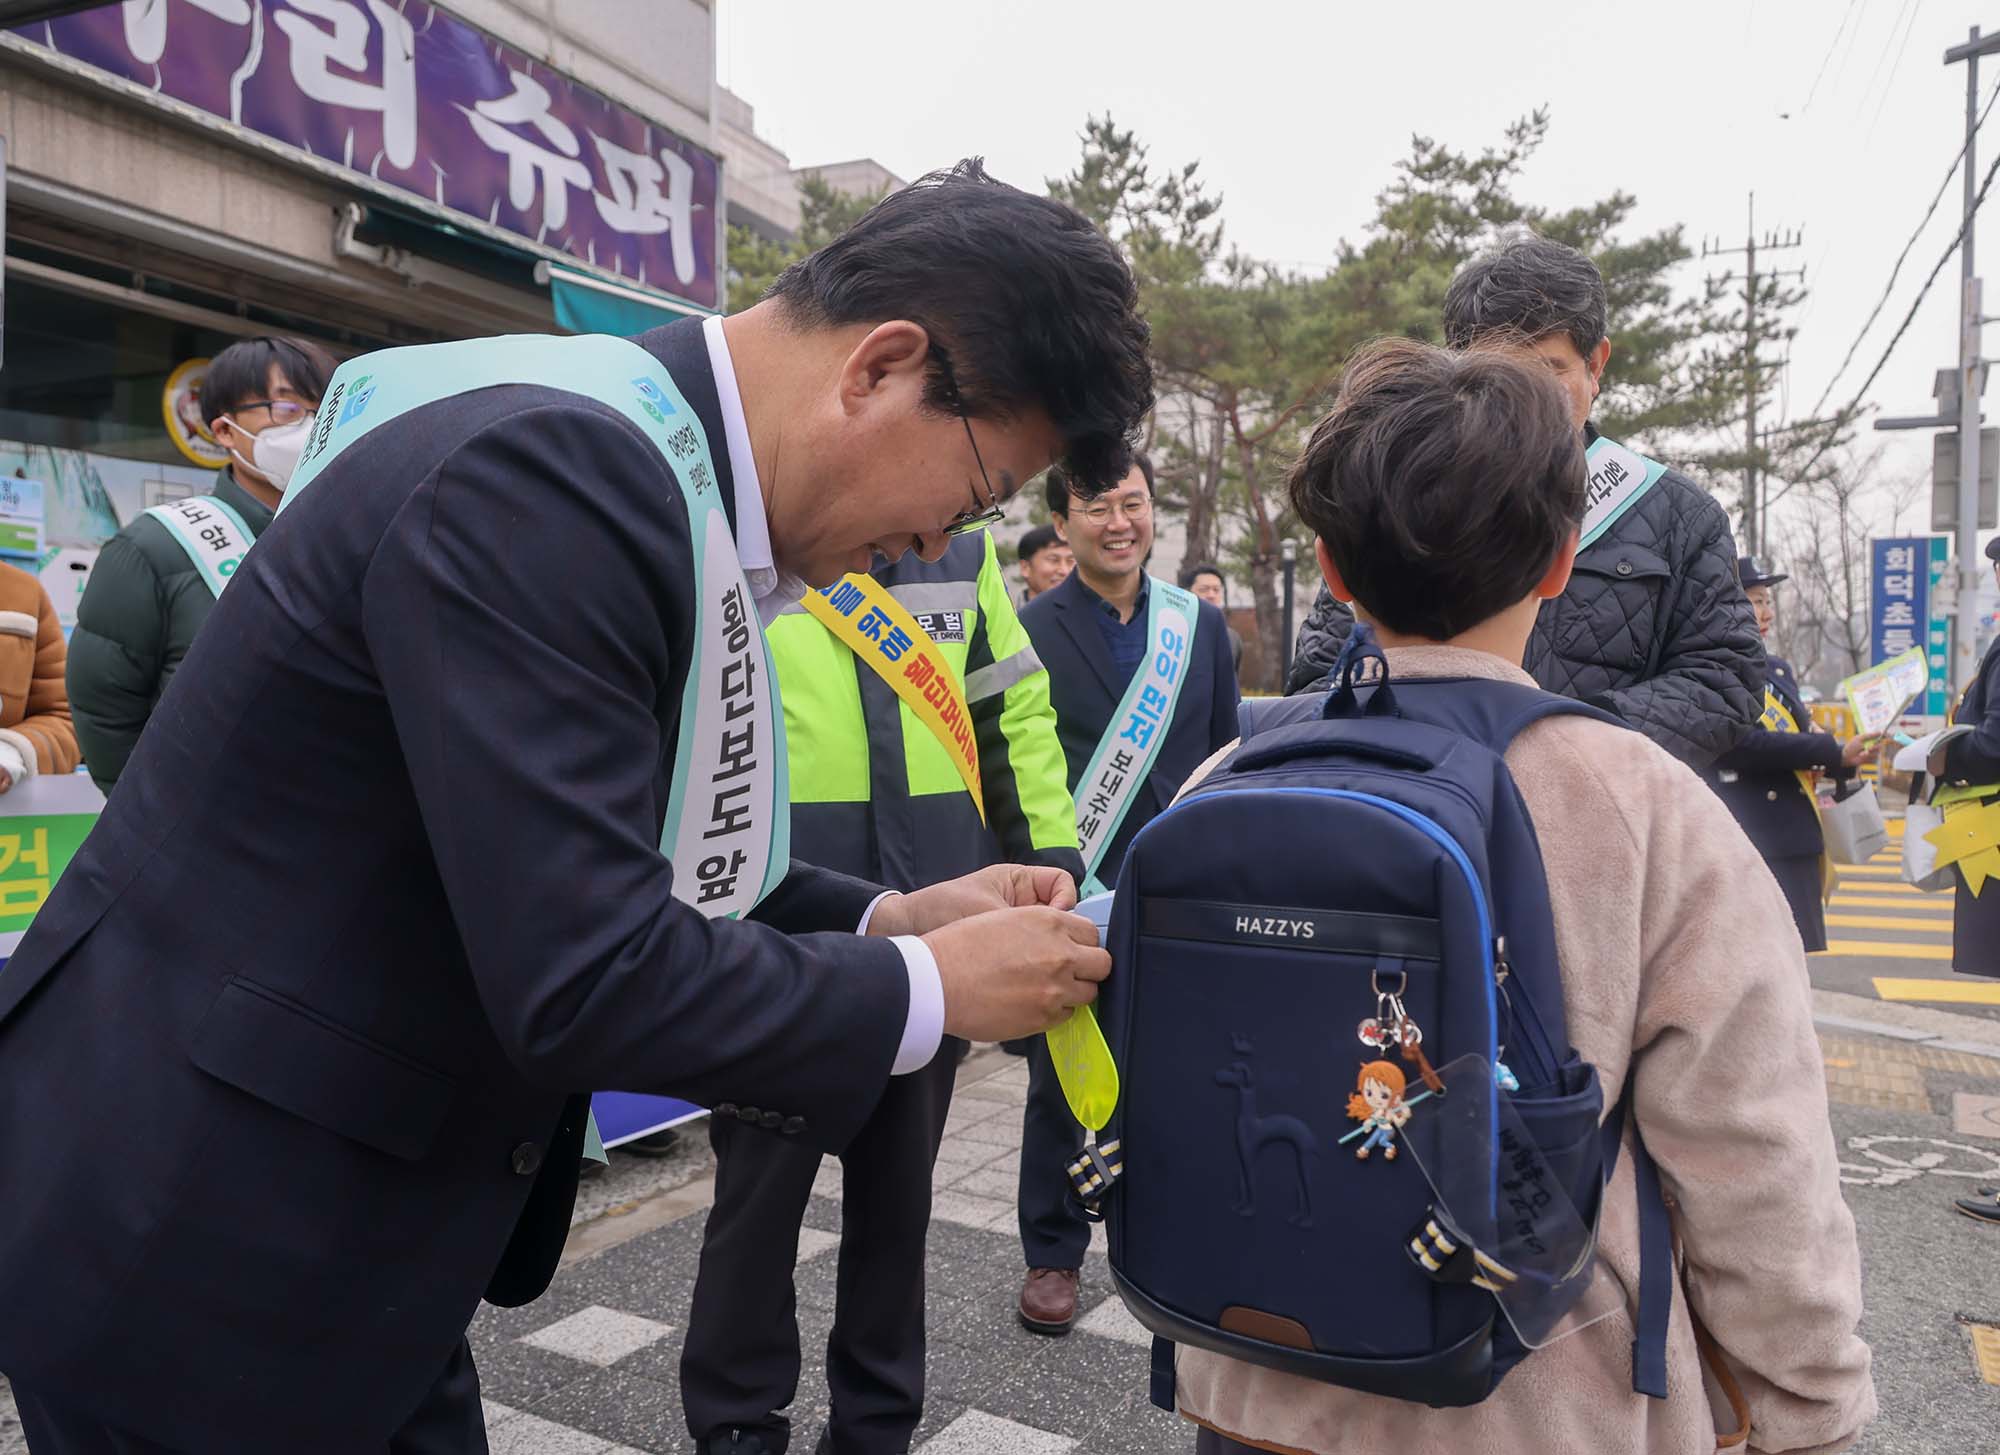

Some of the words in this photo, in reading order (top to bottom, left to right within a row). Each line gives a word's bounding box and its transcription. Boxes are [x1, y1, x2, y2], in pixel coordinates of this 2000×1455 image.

[453, 67, 696, 286] 슈퍼
[311, 382, 346, 460] 아이먼저
[667, 422, 701, 462] 아이먼저
[1585, 458, 1630, 512] 횡단
[200, 525, 232, 553] 앞
[1882, 546, 1915, 658] 회덕초등
[856, 604, 914, 663] 위해
[1155, 627, 1185, 686] 아이
[702, 582, 758, 841] 횡단보도
[1119, 684, 1169, 751] 먼저
[696, 848, 748, 905] 앞
[1235, 915, 1316, 939] HAZZYS
